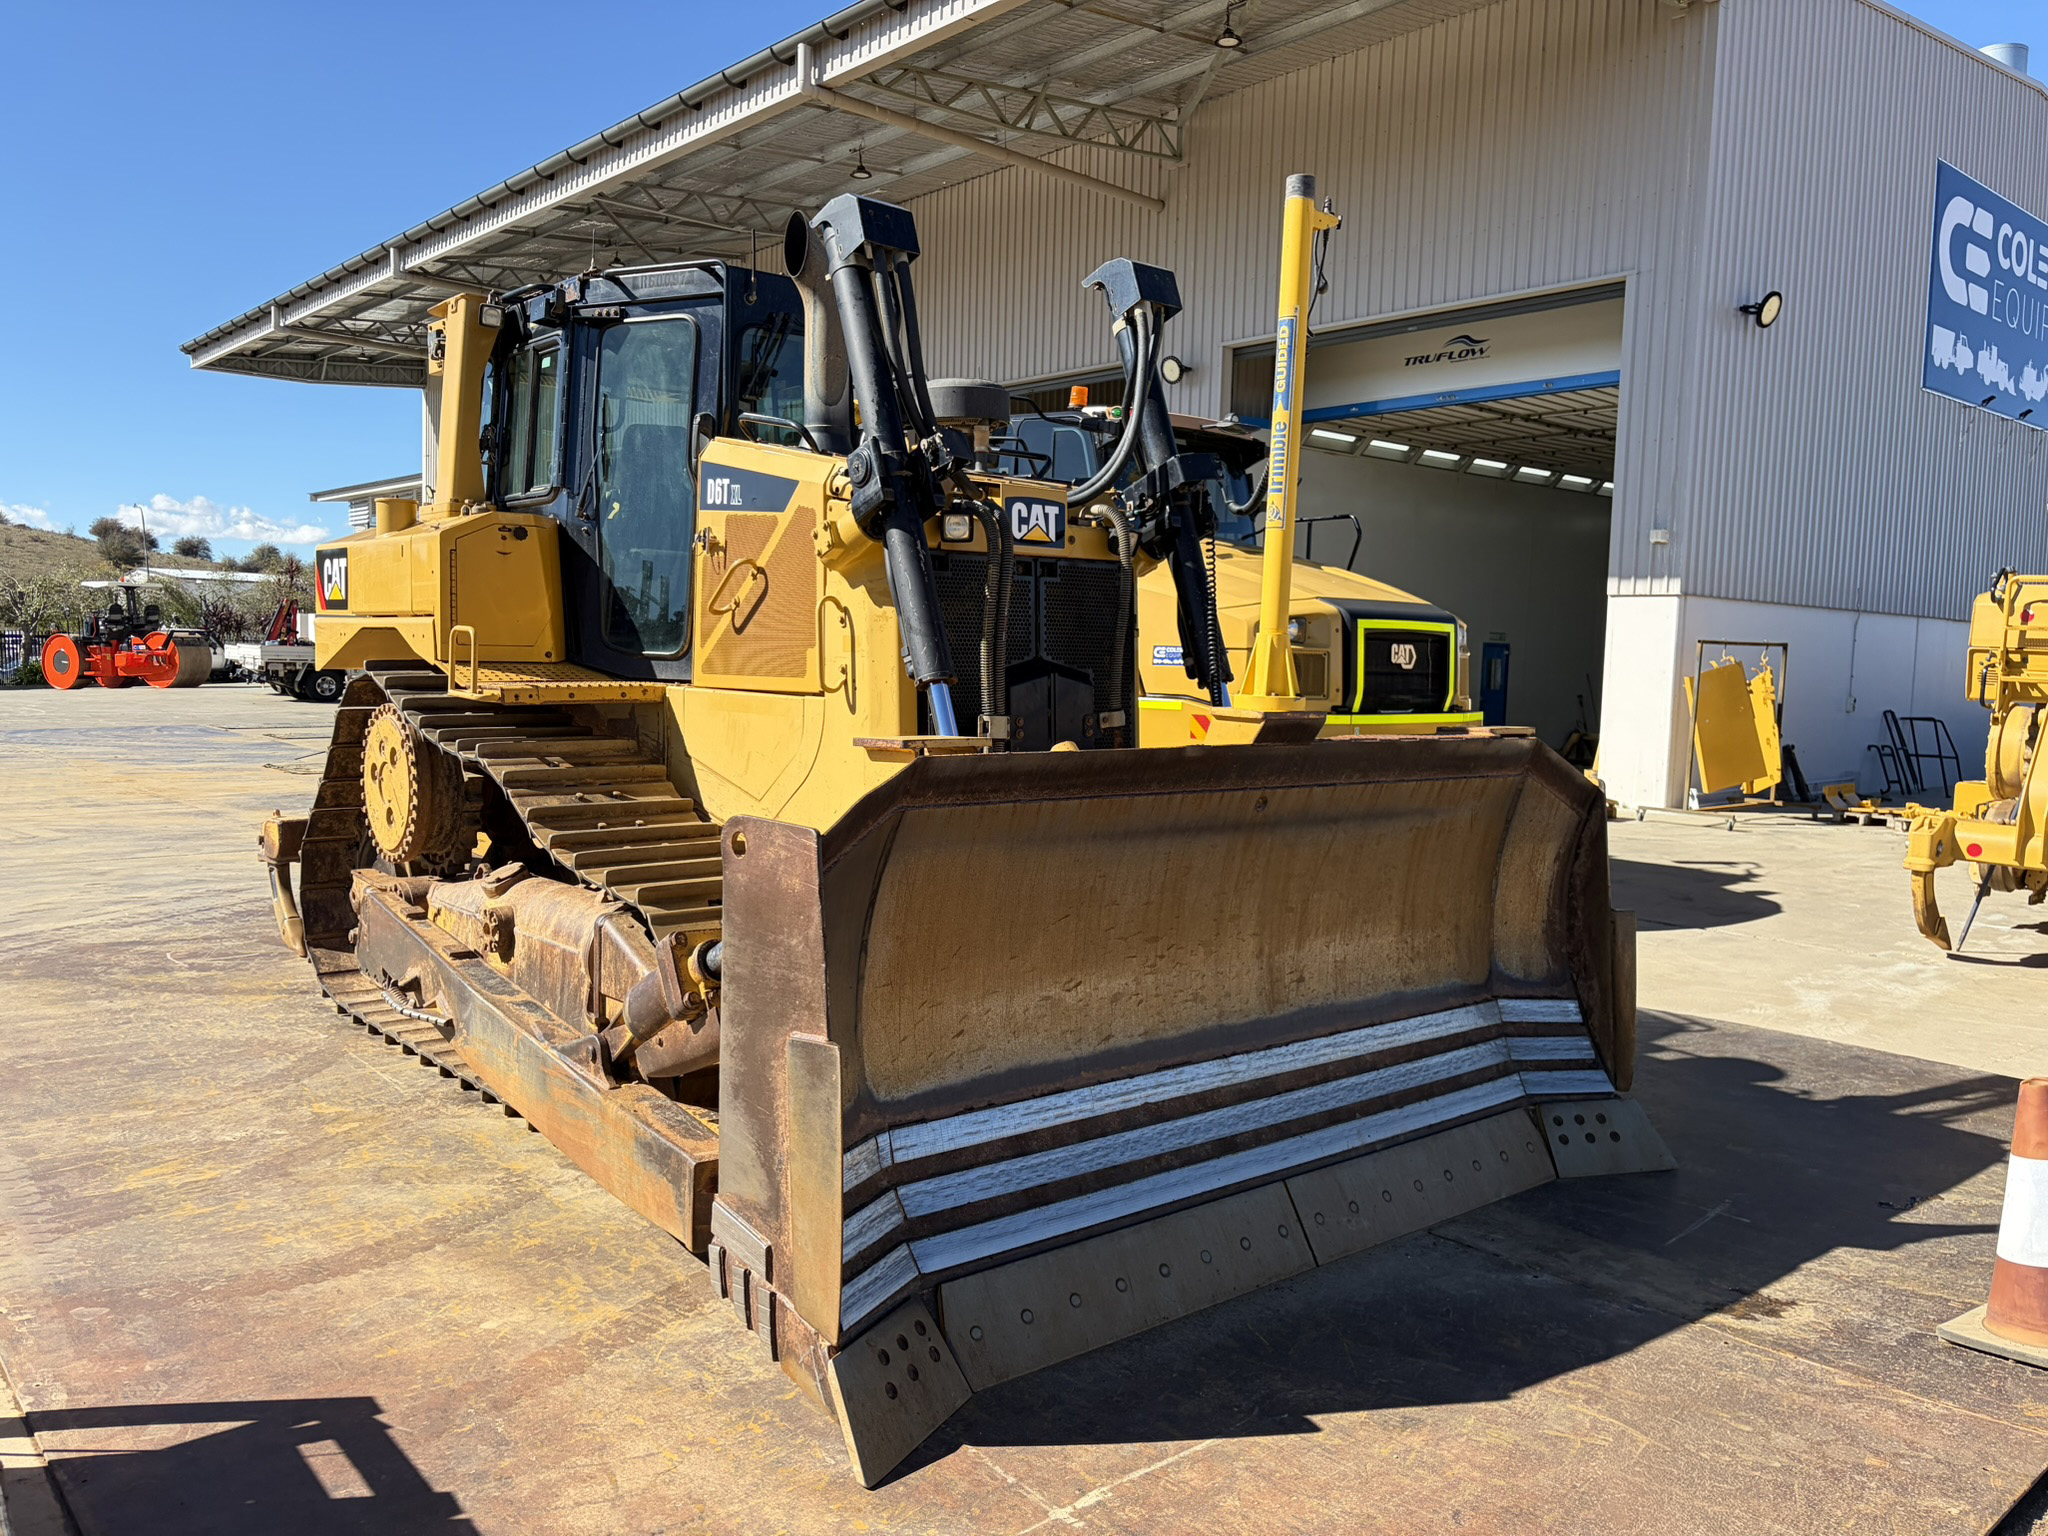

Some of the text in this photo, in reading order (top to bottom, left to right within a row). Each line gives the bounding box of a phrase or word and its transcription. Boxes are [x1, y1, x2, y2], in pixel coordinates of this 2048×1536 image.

[1275, 325, 1291, 394] GUIDED
[1404, 345, 1491, 366] TRUFLOW
[706, 478, 743, 505] D6T XL
[1011, 501, 1060, 543] CAT
[323, 557, 348, 601] CAT
[1391, 643, 1411, 665] CAT
